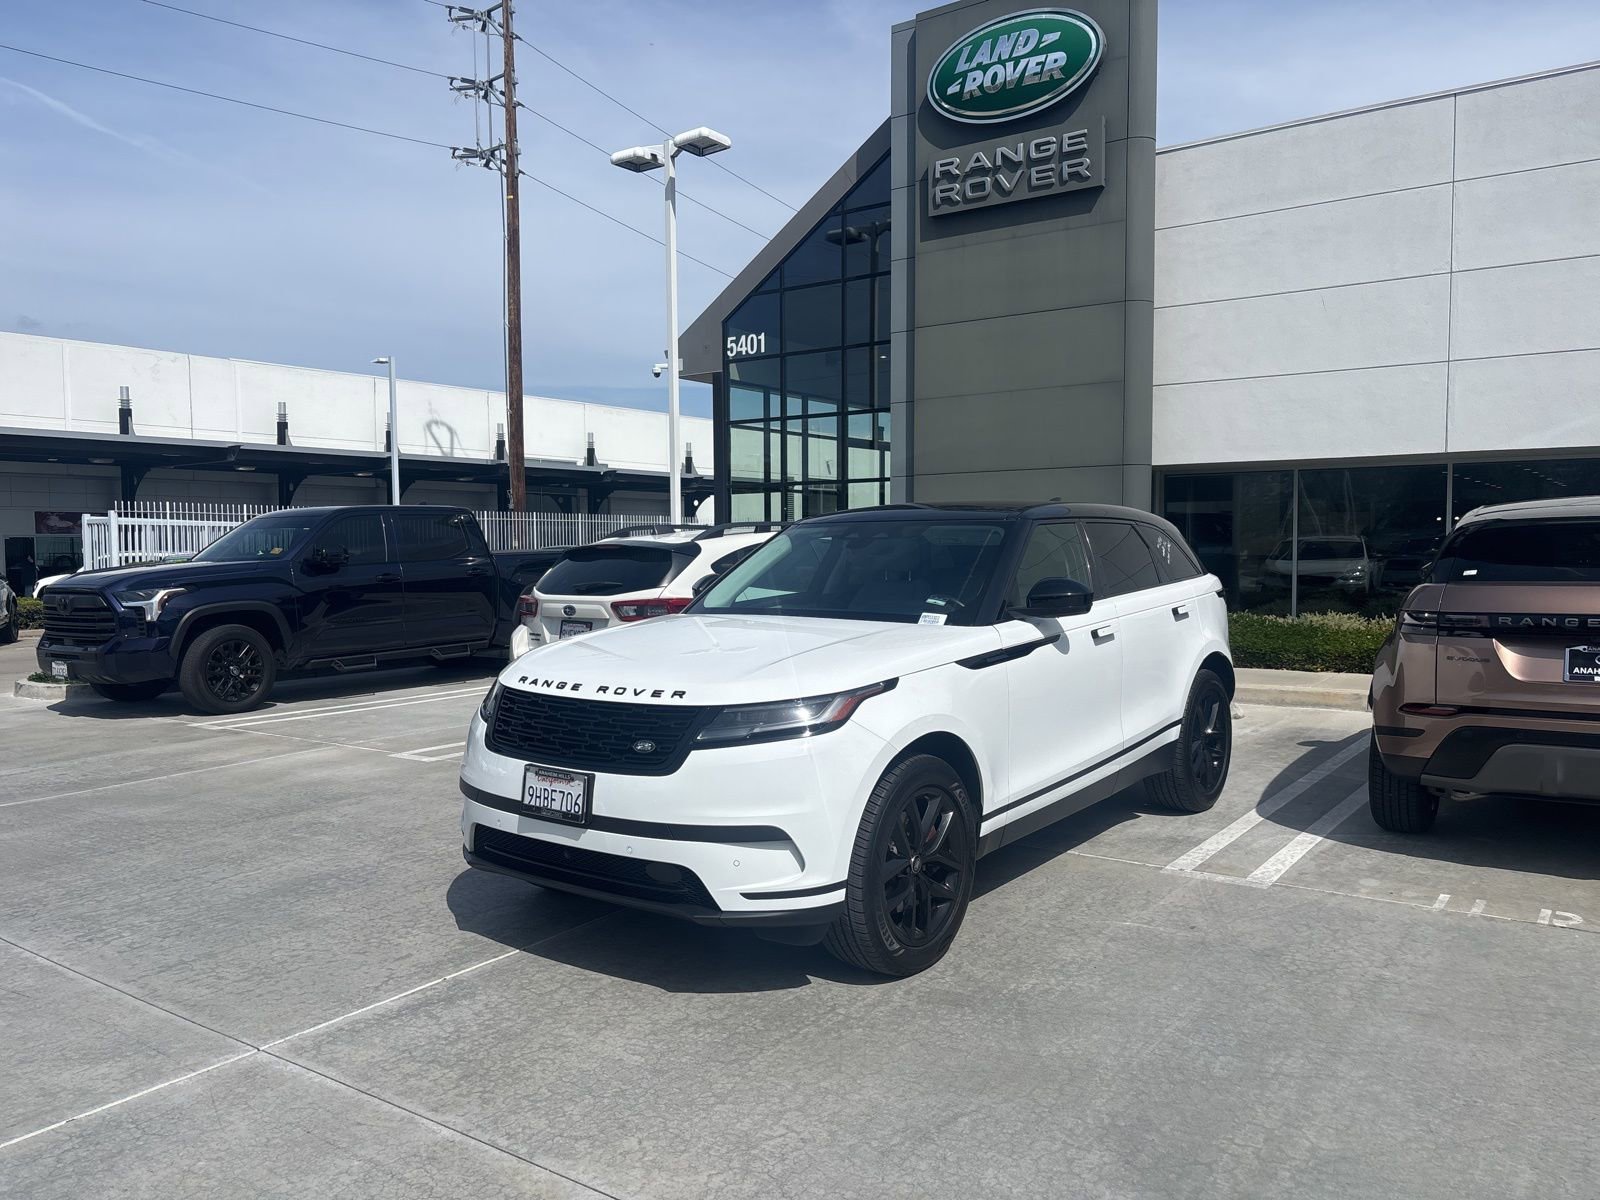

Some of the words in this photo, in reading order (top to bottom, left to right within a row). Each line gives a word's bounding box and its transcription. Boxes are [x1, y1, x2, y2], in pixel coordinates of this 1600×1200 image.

[934, 128, 1088, 180] RANGE
[934, 157, 1092, 206] ROVER
[726, 332, 766, 357] 5401
[1498, 616, 1600, 627] RANGE
[518, 675, 583, 692] RANGE
[596, 685, 687, 699] ROVER
[528, 785, 581, 814] 9HBF706
